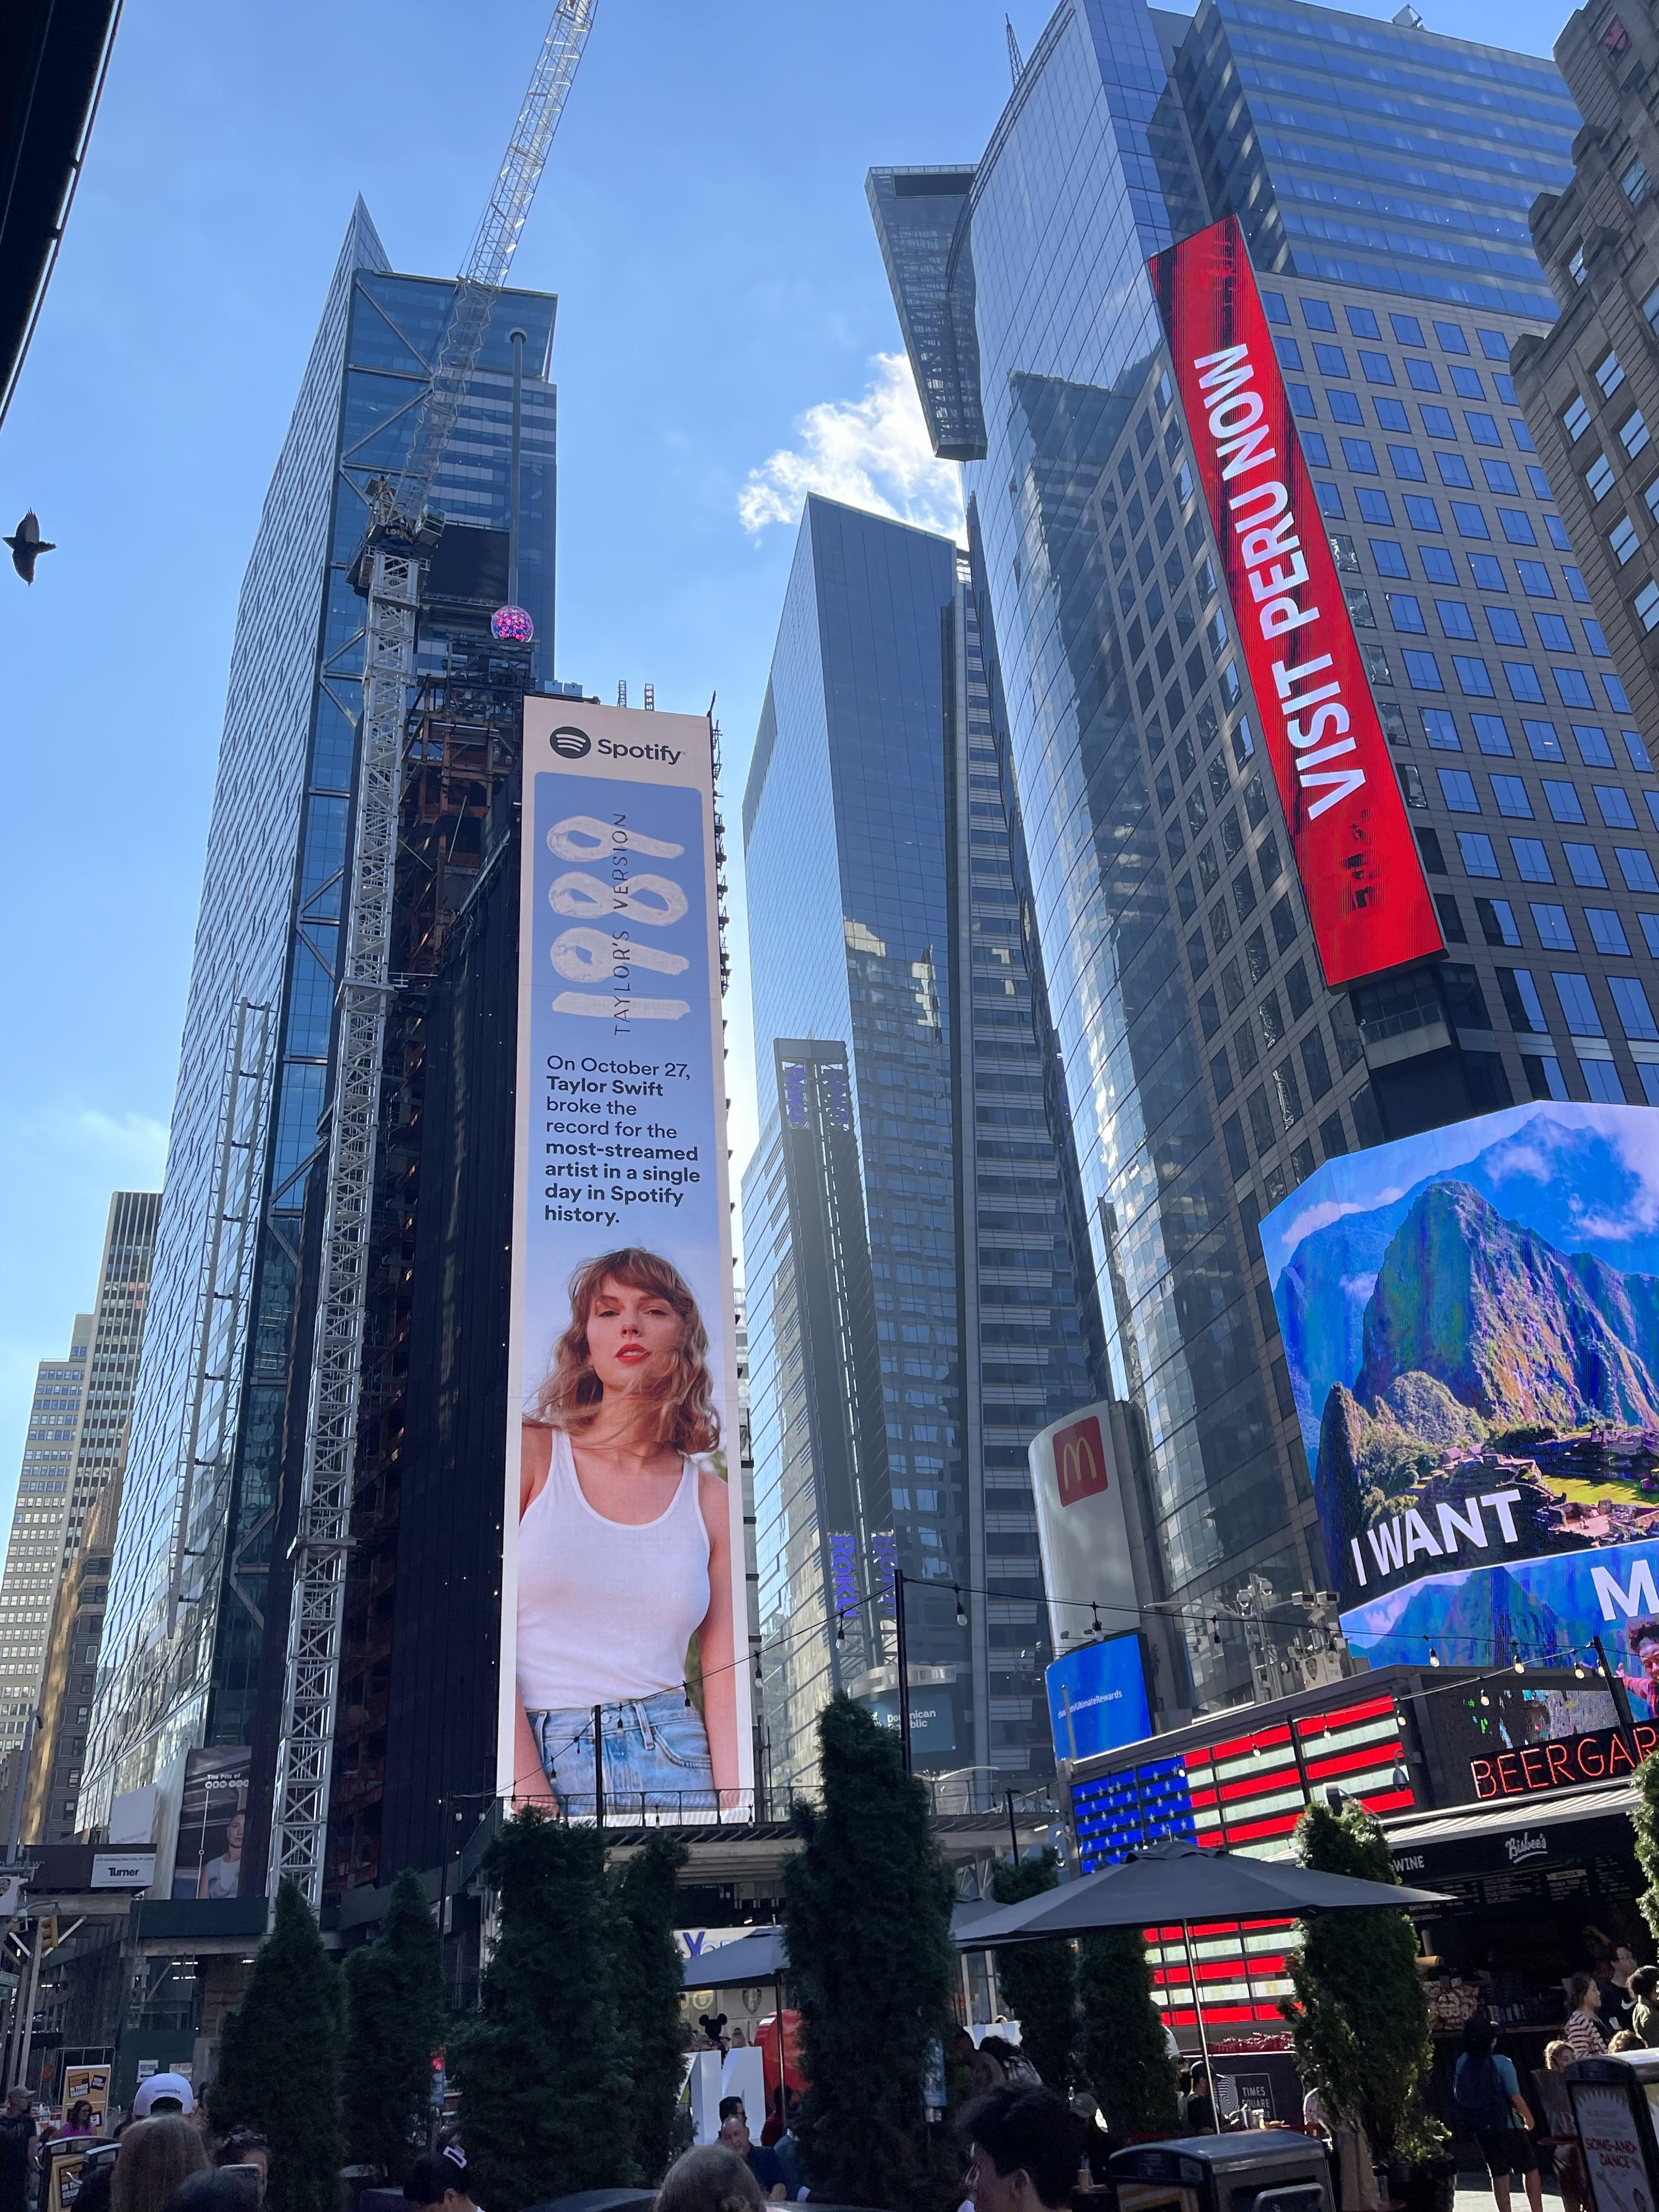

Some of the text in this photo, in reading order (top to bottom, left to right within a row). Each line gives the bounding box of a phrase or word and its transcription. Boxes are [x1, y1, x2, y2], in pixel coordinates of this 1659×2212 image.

[1194, 343, 1366, 821] VISIT PERU NOW
[597, 738, 681, 765] Spotify
[612, 814, 631, 1035] TAYLOR'S VERSION
[546, 1056, 691, 1080] On October 27,
[546, 1076, 663, 1096] Taylor Swift
[546, 1097, 637, 1115] broke the
[546, 1120, 677, 1139] record for the
[546, 1142, 698, 1161] most-streamed
[545, 1162, 701, 1186] artist in a single
[545, 1183, 684, 1207] day in Spotify
[545, 1206, 619, 1226] history.
[1351, 1488, 1522, 1587] I WANT
[830, 1537, 857, 1615] ROKU
[887, 1710, 936, 1723] Donican
[108, 1867, 140, 1876] Turner
[1392, 1855, 1425, 1872] WINE
[1242, 2086, 1266, 2096] TIMES
